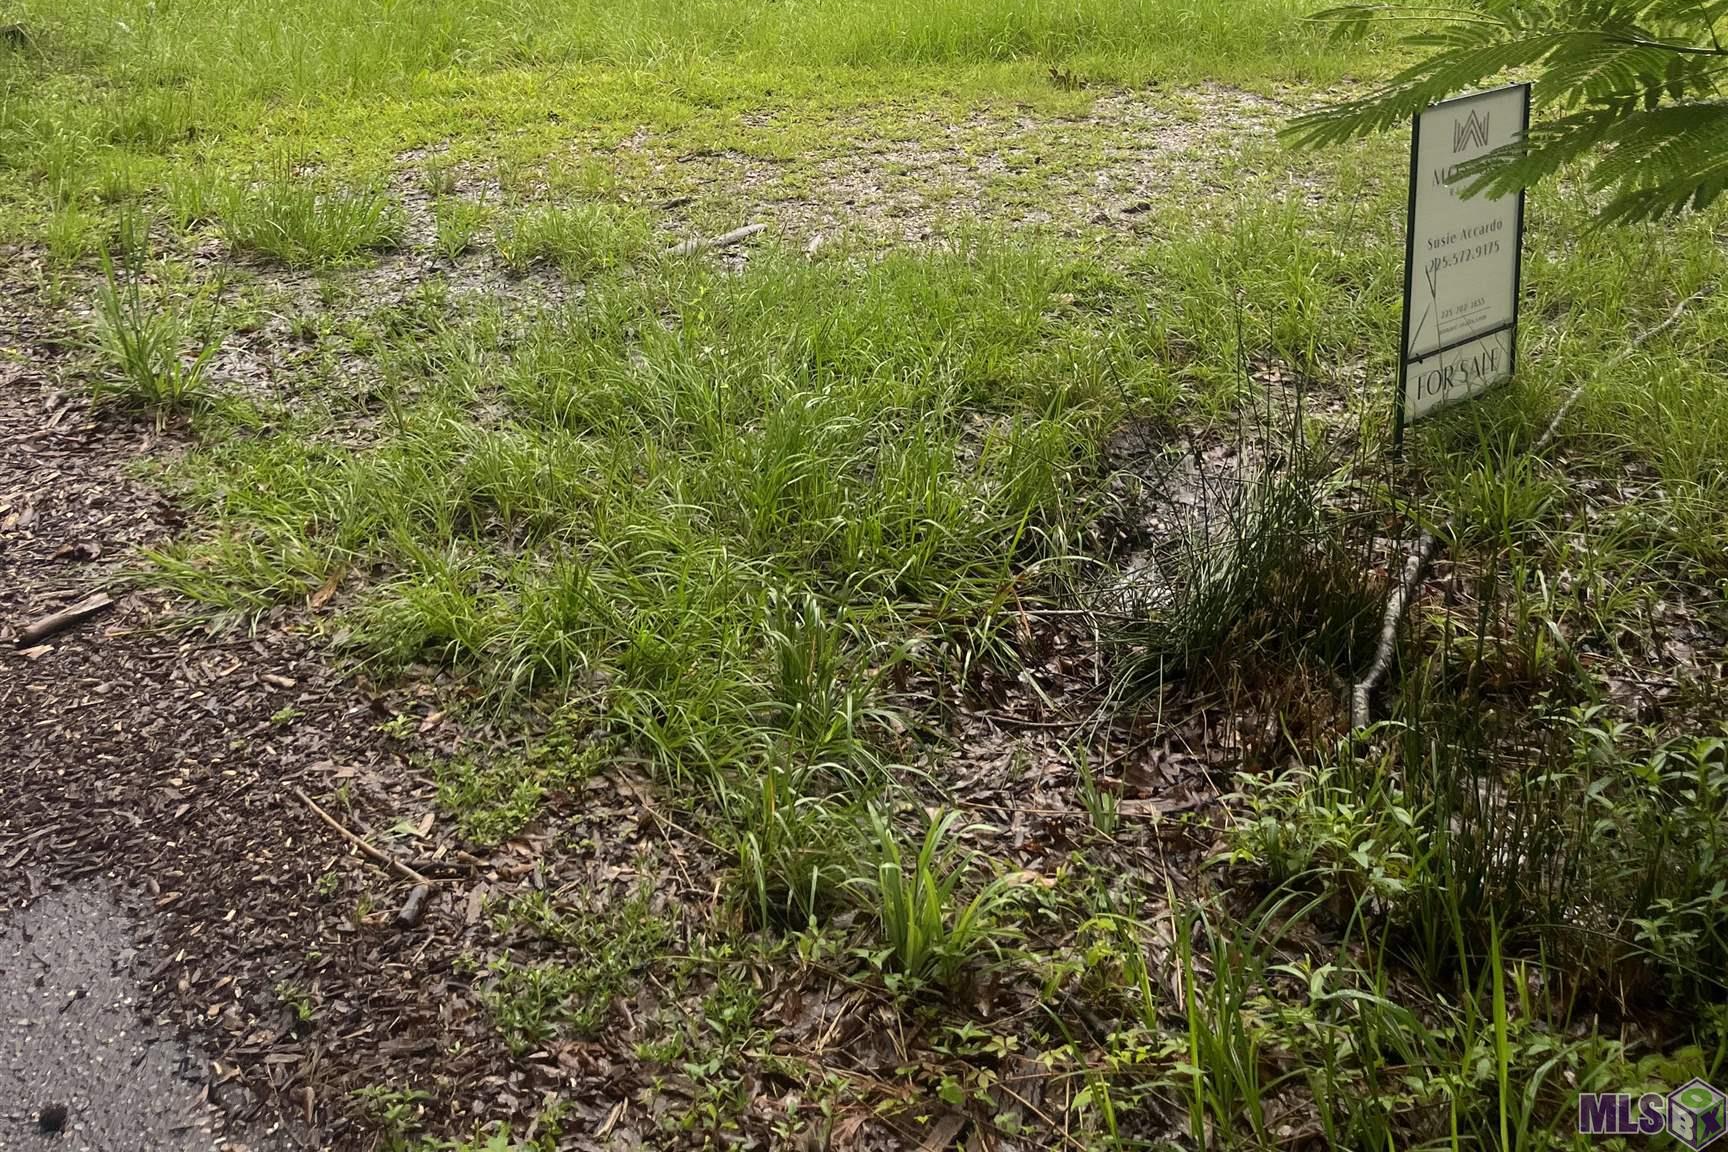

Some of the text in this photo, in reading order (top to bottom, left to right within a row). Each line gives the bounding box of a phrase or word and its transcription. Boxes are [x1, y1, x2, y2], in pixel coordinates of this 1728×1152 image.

[1427, 218, 1503, 250] Susie Accardo
[1417, 349, 1499, 400] FOR SALE
